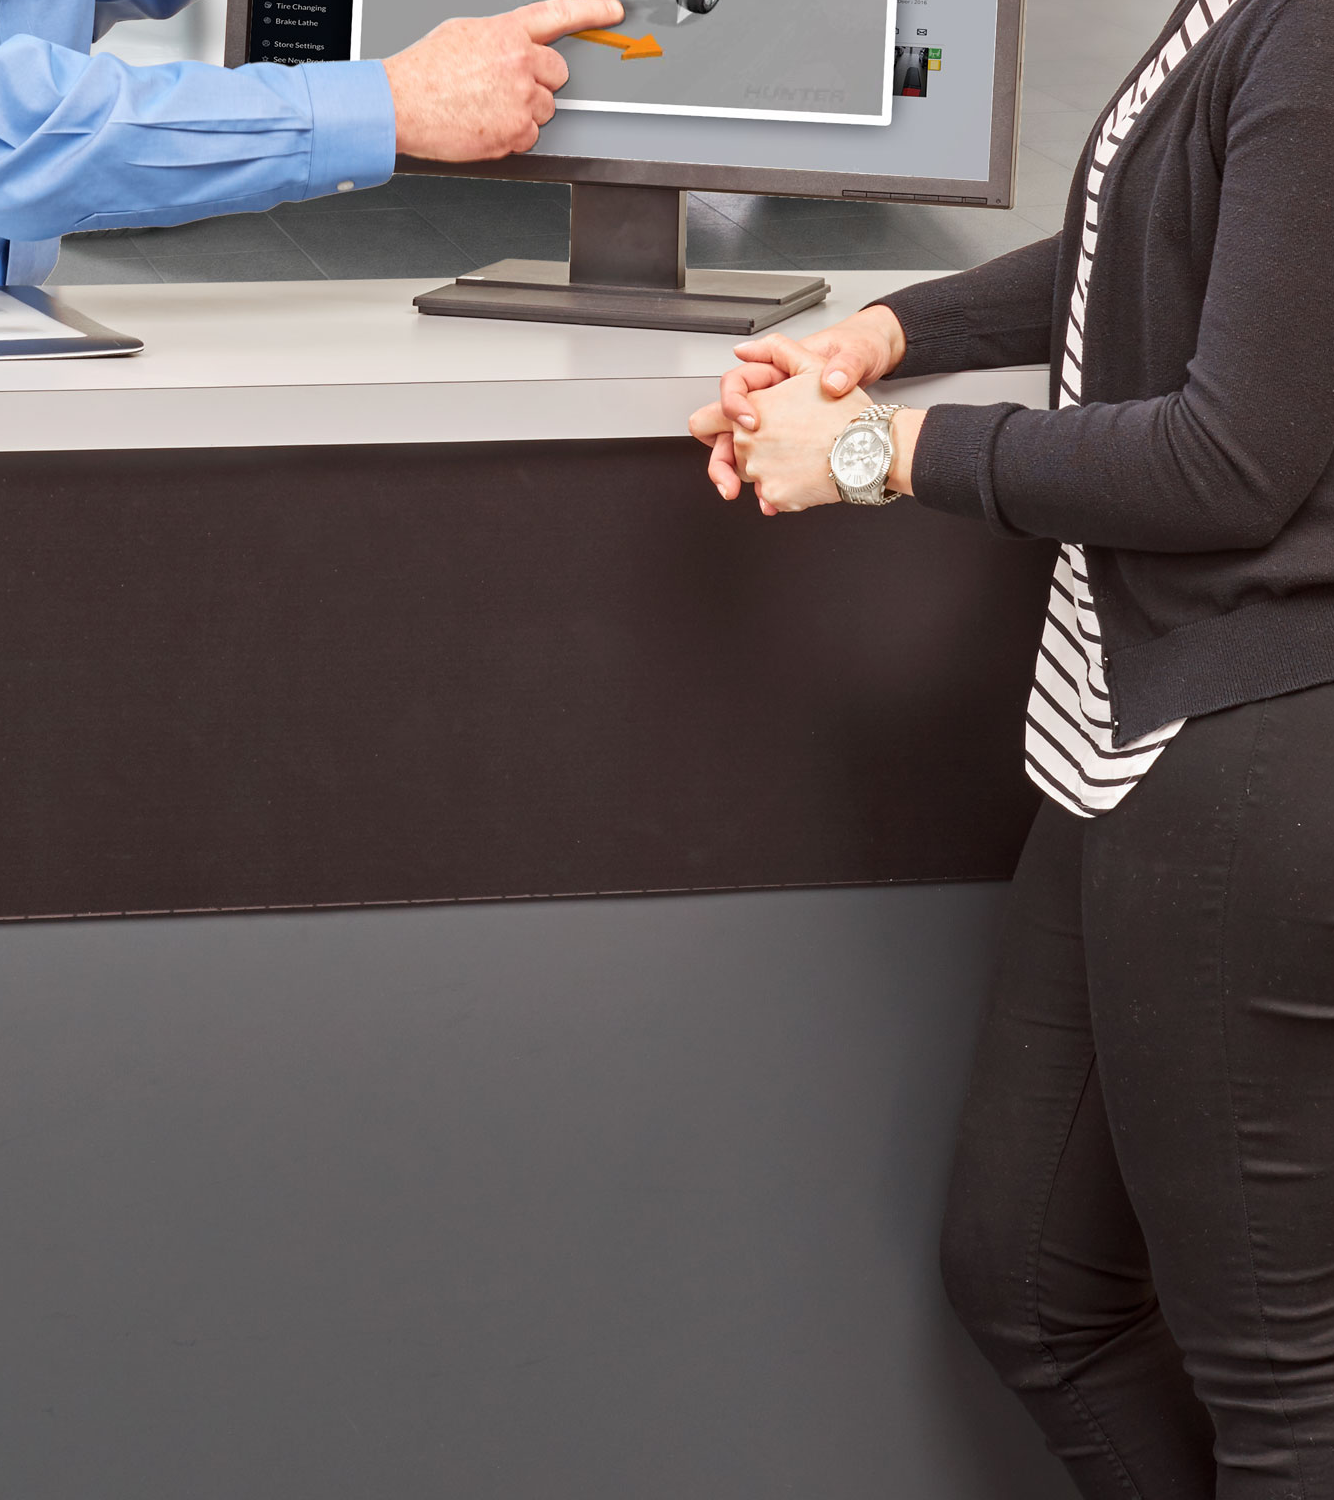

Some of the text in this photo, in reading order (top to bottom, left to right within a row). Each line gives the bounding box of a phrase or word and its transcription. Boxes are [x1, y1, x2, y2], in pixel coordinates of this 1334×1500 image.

[276, 2, 327, 13] Tire Changing
[275, 18, 319, 27] Brake Lathe
[274, 40, 325, 51] Store Settings
